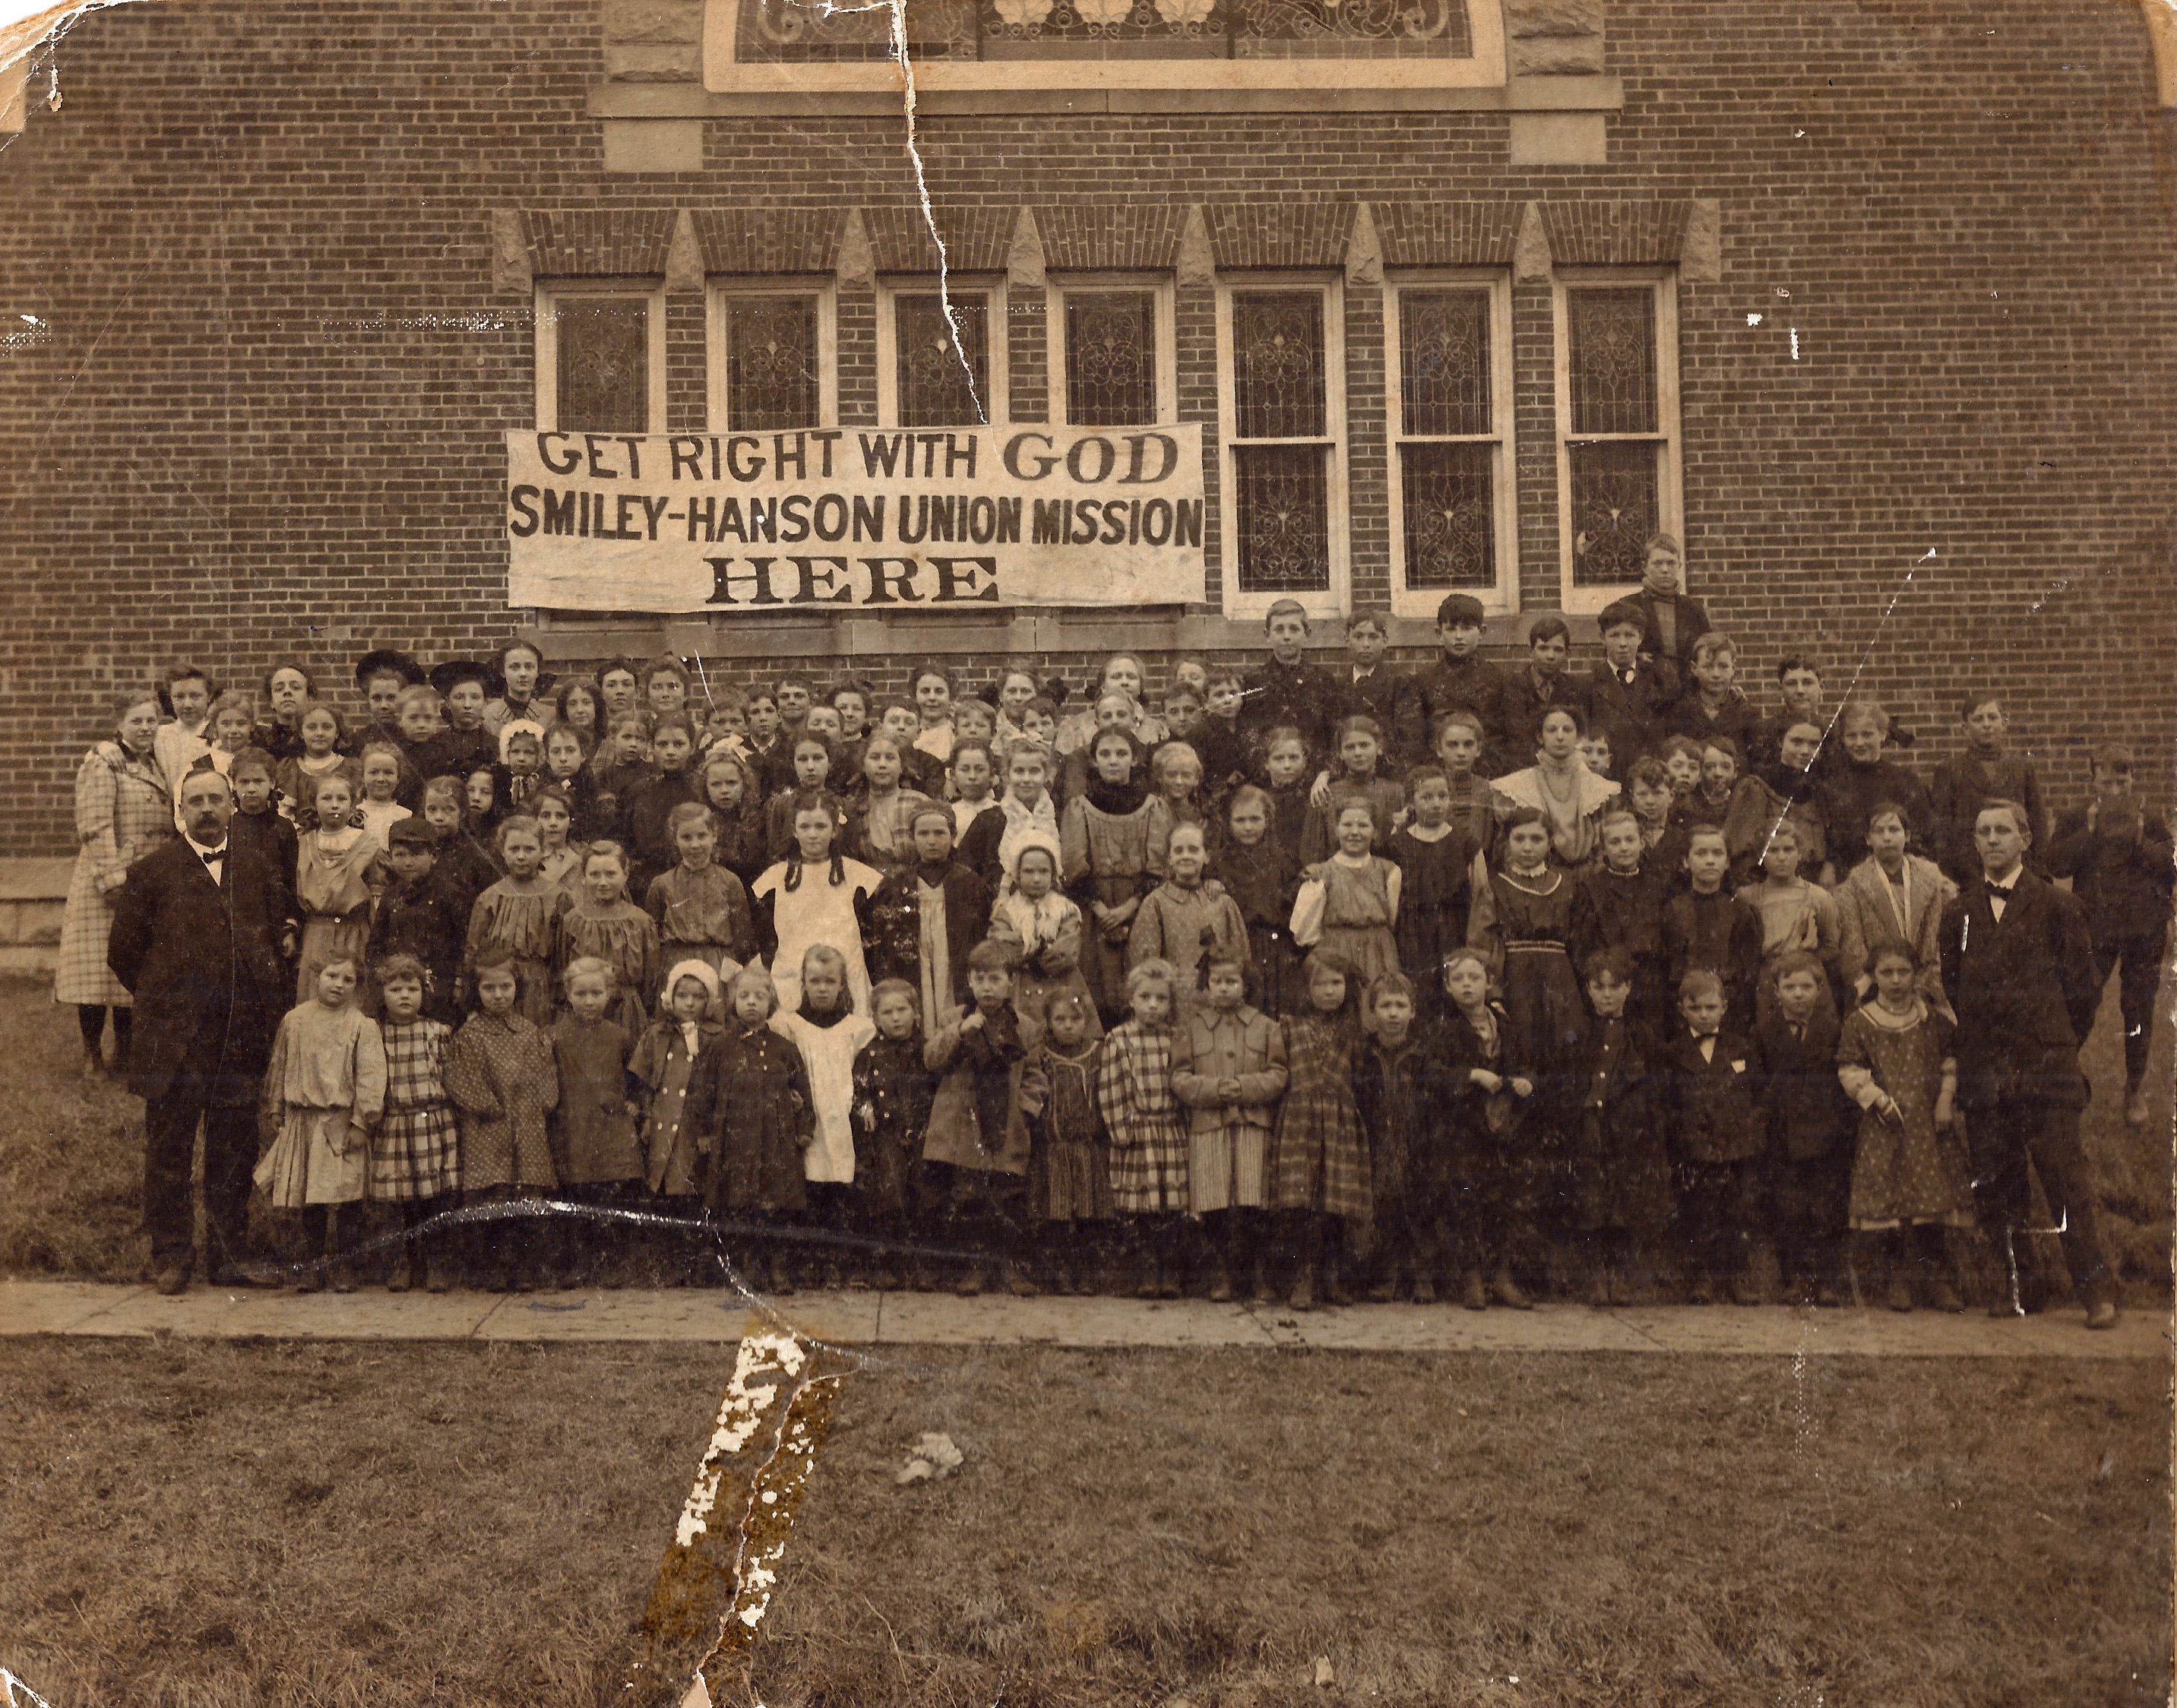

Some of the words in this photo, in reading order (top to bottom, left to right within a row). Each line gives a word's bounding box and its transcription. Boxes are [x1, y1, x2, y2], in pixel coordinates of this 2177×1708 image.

[537, 432, 646, 479] GET
[669, 432, 842, 482] RIGHT
[859, 434, 977, 479] WITH
[1003, 432, 1179, 484] GOD
[510, 485, 885, 543] SMILEY-HANSON
[898, 495, 1021, 544] UNION
[1032, 498, 1203, 548] MISSION
[703, 557, 999, 604] HERE
